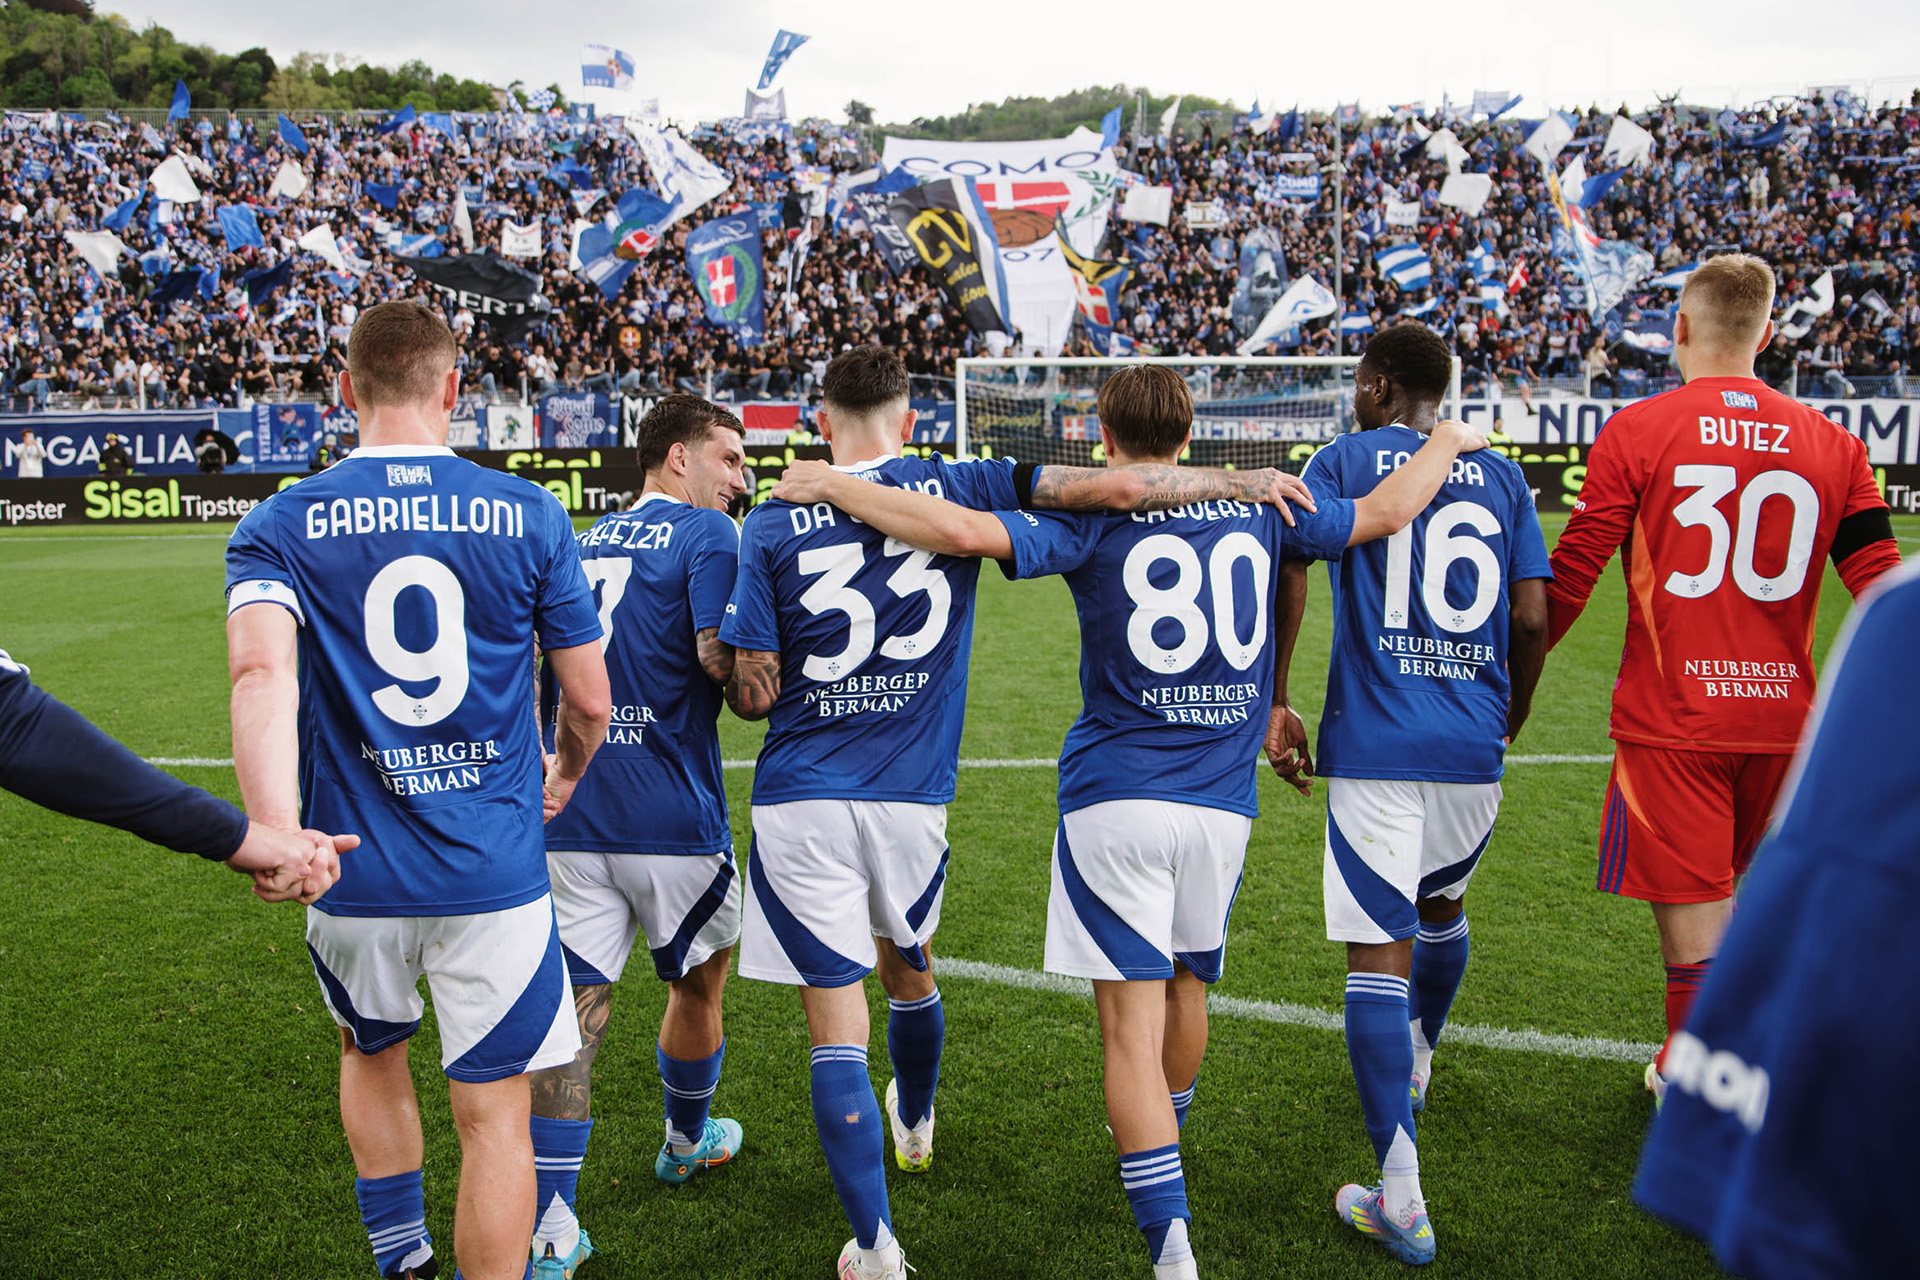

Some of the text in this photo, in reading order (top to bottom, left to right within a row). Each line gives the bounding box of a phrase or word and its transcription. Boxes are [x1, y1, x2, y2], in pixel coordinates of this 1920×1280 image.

[901, 151, 1101, 176] COMO
[1003, 248, 1054, 261] 07
[1699, 416, 1790, 453] BUTEZ
[1376, 450, 1485, 486] FARA
[84, 478, 259, 522] Sisal Tipster
[306, 495, 525, 540] GABRIELLONI
[790, 503, 836, 536] DA
[1664, 464, 1820, 601] 30
[1384, 501, 1502, 633] 16
[581, 557, 632, 657] 7
[798, 535, 951, 682] 33
[1122, 532, 1271, 674] 80
[364, 555, 469, 727] 9
[1378, 635, 1495, 662] NEUBERGER
[1399, 658, 1478, 681] BERMAN
[1684, 659, 1800, 679] NEUBERGER
[804, 671, 929, 704] NEUBERGER
[1141, 682, 1260, 706] NEUBERGER
[1705, 681, 1789, 699] BERMAN
[818, 695, 910, 717] BERMAN
[1166, 707, 1249, 725] BERMAN
[361, 739, 502, 768] NEUBERGER
[384, 766, 482, 797] BERMAN
